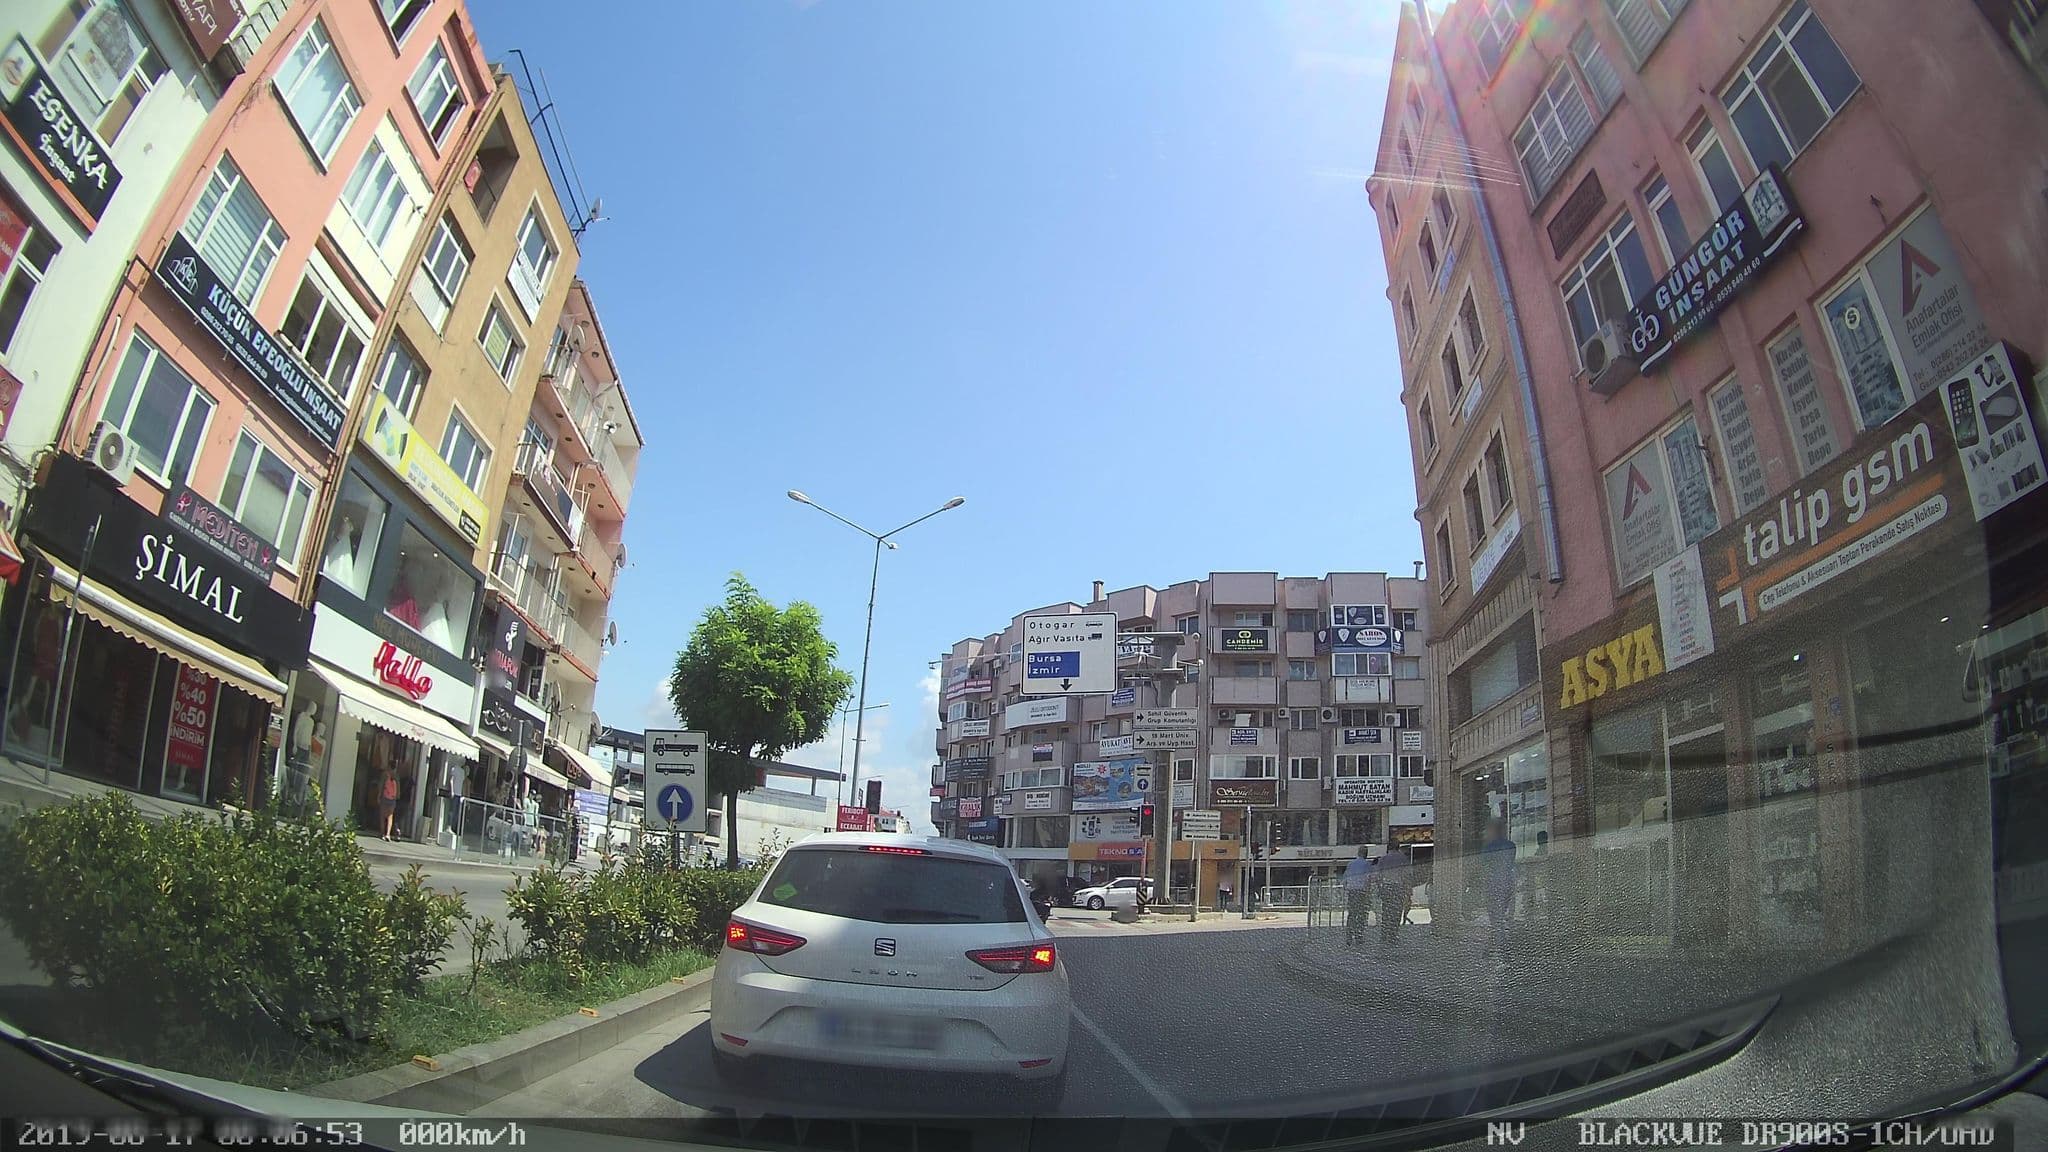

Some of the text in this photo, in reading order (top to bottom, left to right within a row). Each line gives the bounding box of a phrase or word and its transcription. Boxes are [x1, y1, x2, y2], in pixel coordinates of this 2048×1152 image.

[29, 79, 108, 189] ESENKA
[1655, 210, 1745, 310] GÜNGÖR
[1668, 240, 1744, 324] İNŞAAT
[1905, 283, 1960, 334] Anafartalar
[1911, 320, 1941, 349] Emlak
[1940, 300, 1964, 326] Ofisi
[208, 283, 252, 341] KÜÇÜK
[252, 330, 304, 393] EFEOĞLU
[300, 379, 342, 430] İNŞAAT
[1743, 488, 1830, 566] talip
[1842, 422, 1934, 524] gsm
[135, 534, 243, 624] ŞİMAL
[1028, 634, 1085, 644] Ağır Vasıta
[1029, 621, 1075, 630] Otogar
[1028, 654, 1062, 663] Bursa
[1561, 623, 1666, 710] ASYA
[174, 701, 206, 729] %50
[181, 682, 206, 705] %40
[1099, 847, 1143, 855] TEKNOSA
